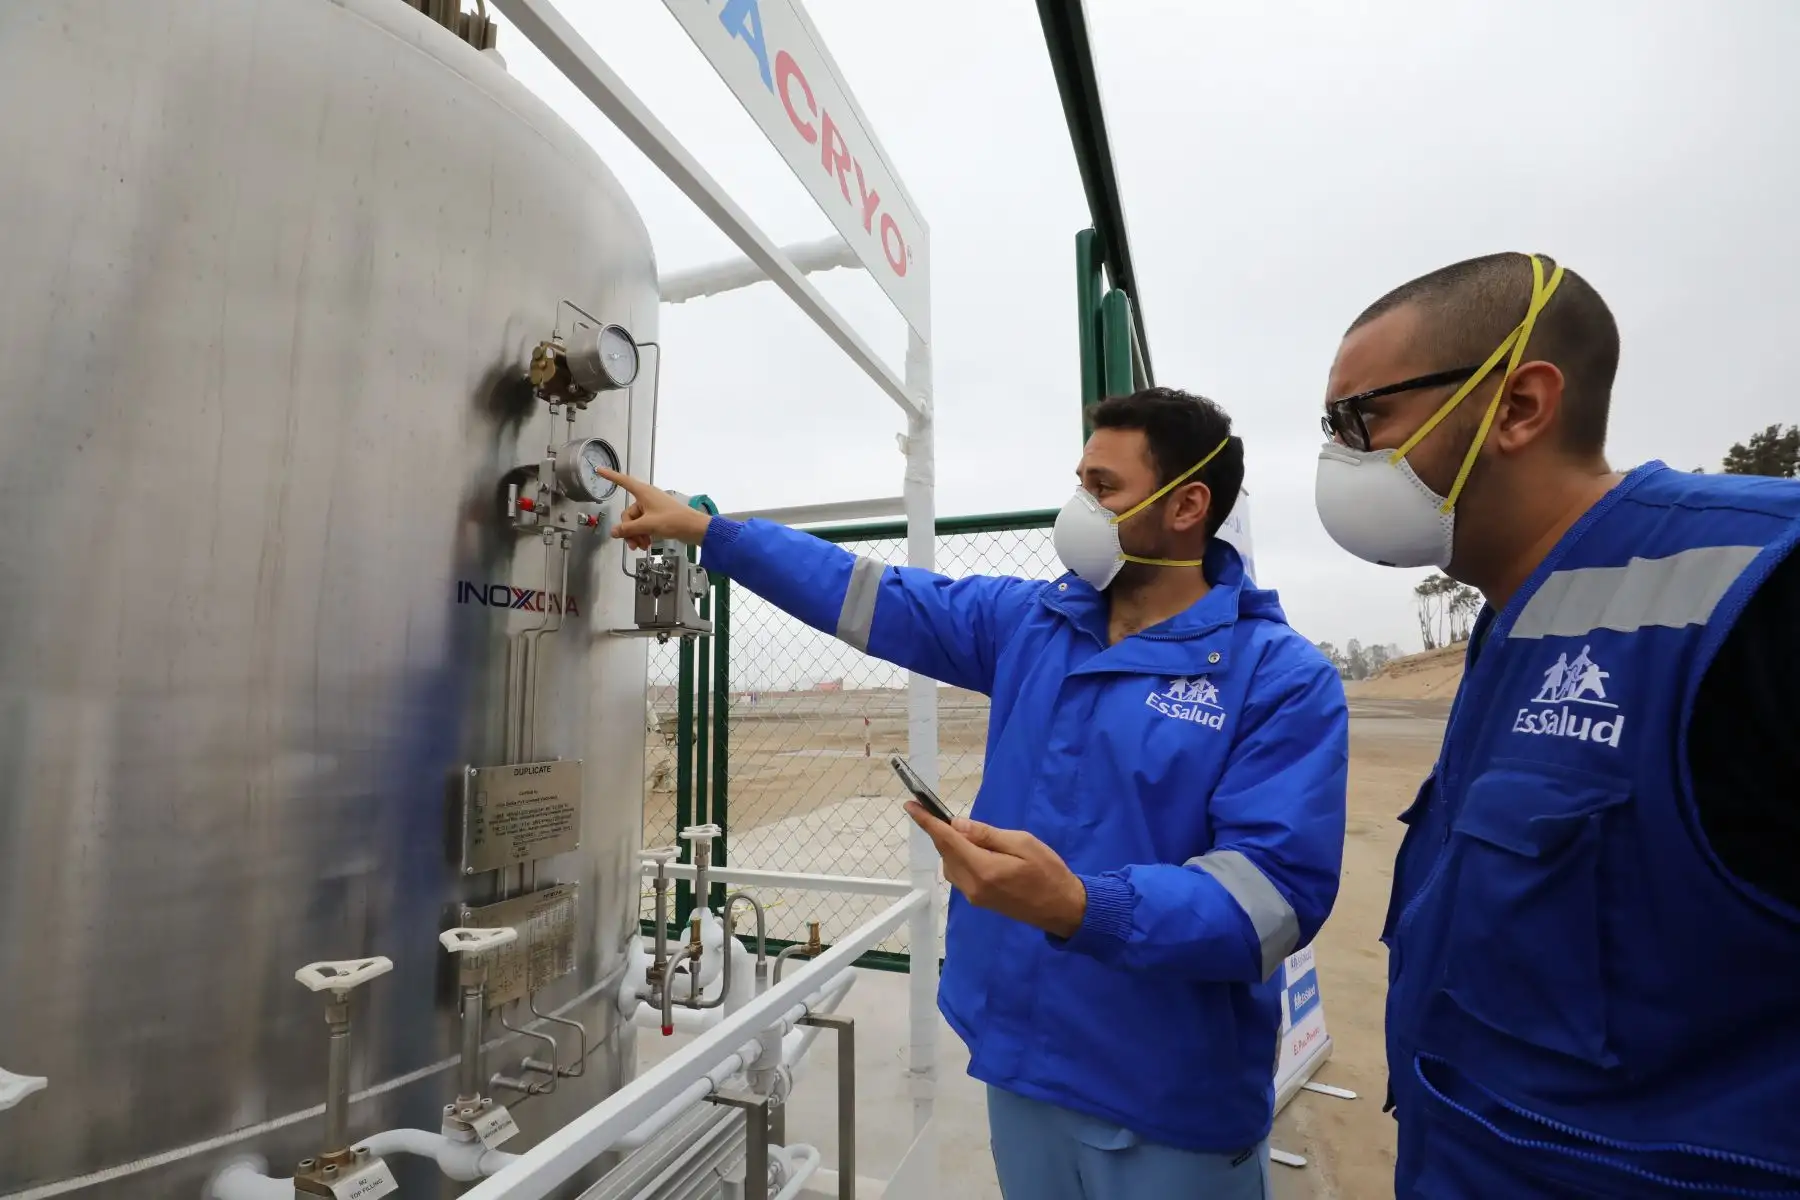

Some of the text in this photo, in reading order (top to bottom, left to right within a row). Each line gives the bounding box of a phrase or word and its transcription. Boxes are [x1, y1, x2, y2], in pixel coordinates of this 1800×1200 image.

[1145, 691, 1226, 731] EsSalud
[1512, 705, 1625, 748] EsSalud
[513, 765, 552, 776] DUPLICATE
